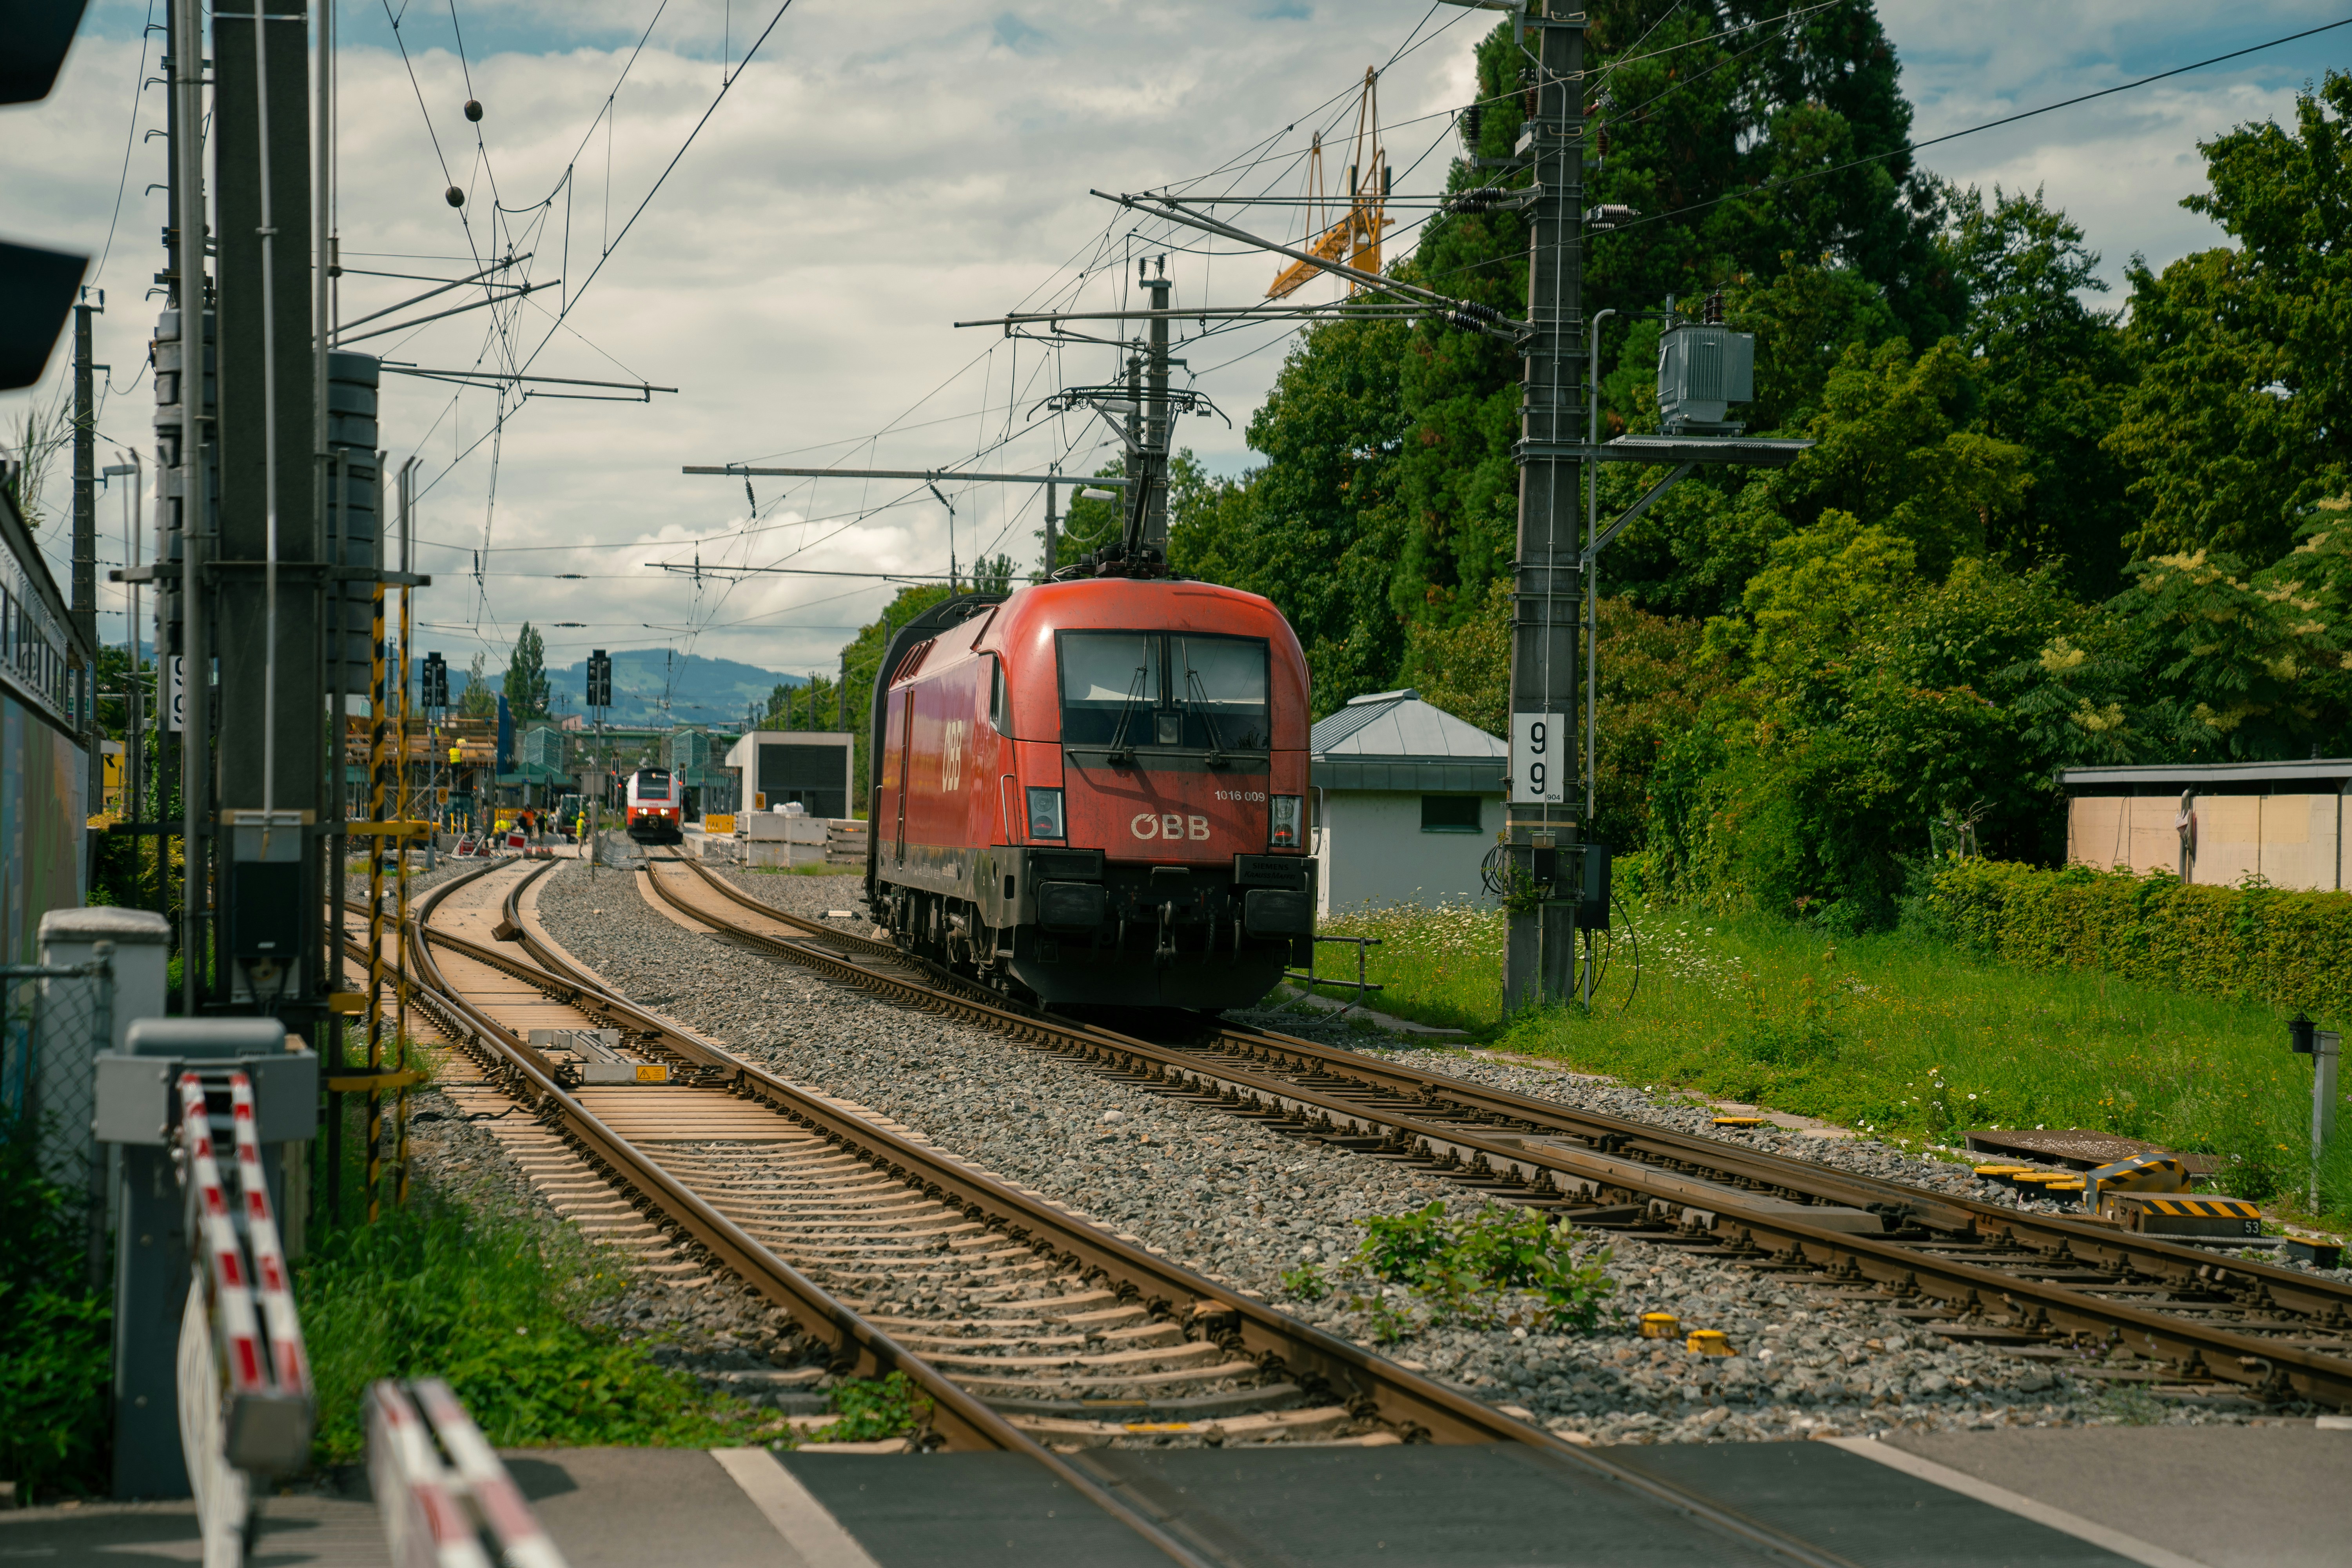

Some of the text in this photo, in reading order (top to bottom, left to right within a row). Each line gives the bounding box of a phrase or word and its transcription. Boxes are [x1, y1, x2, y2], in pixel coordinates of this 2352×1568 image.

[1530, 722, 1546, 754] 9
[942, 720, 962, 793] ÖBB
[1530, 762, 1545, 795] 9
[757, 797, 762, 805] 6
[1215, 790, 1265, 802] 1016 009
[1131, 813, 1210, 840] ÖBB
[2245, 1221, 2259, 1234] 53
